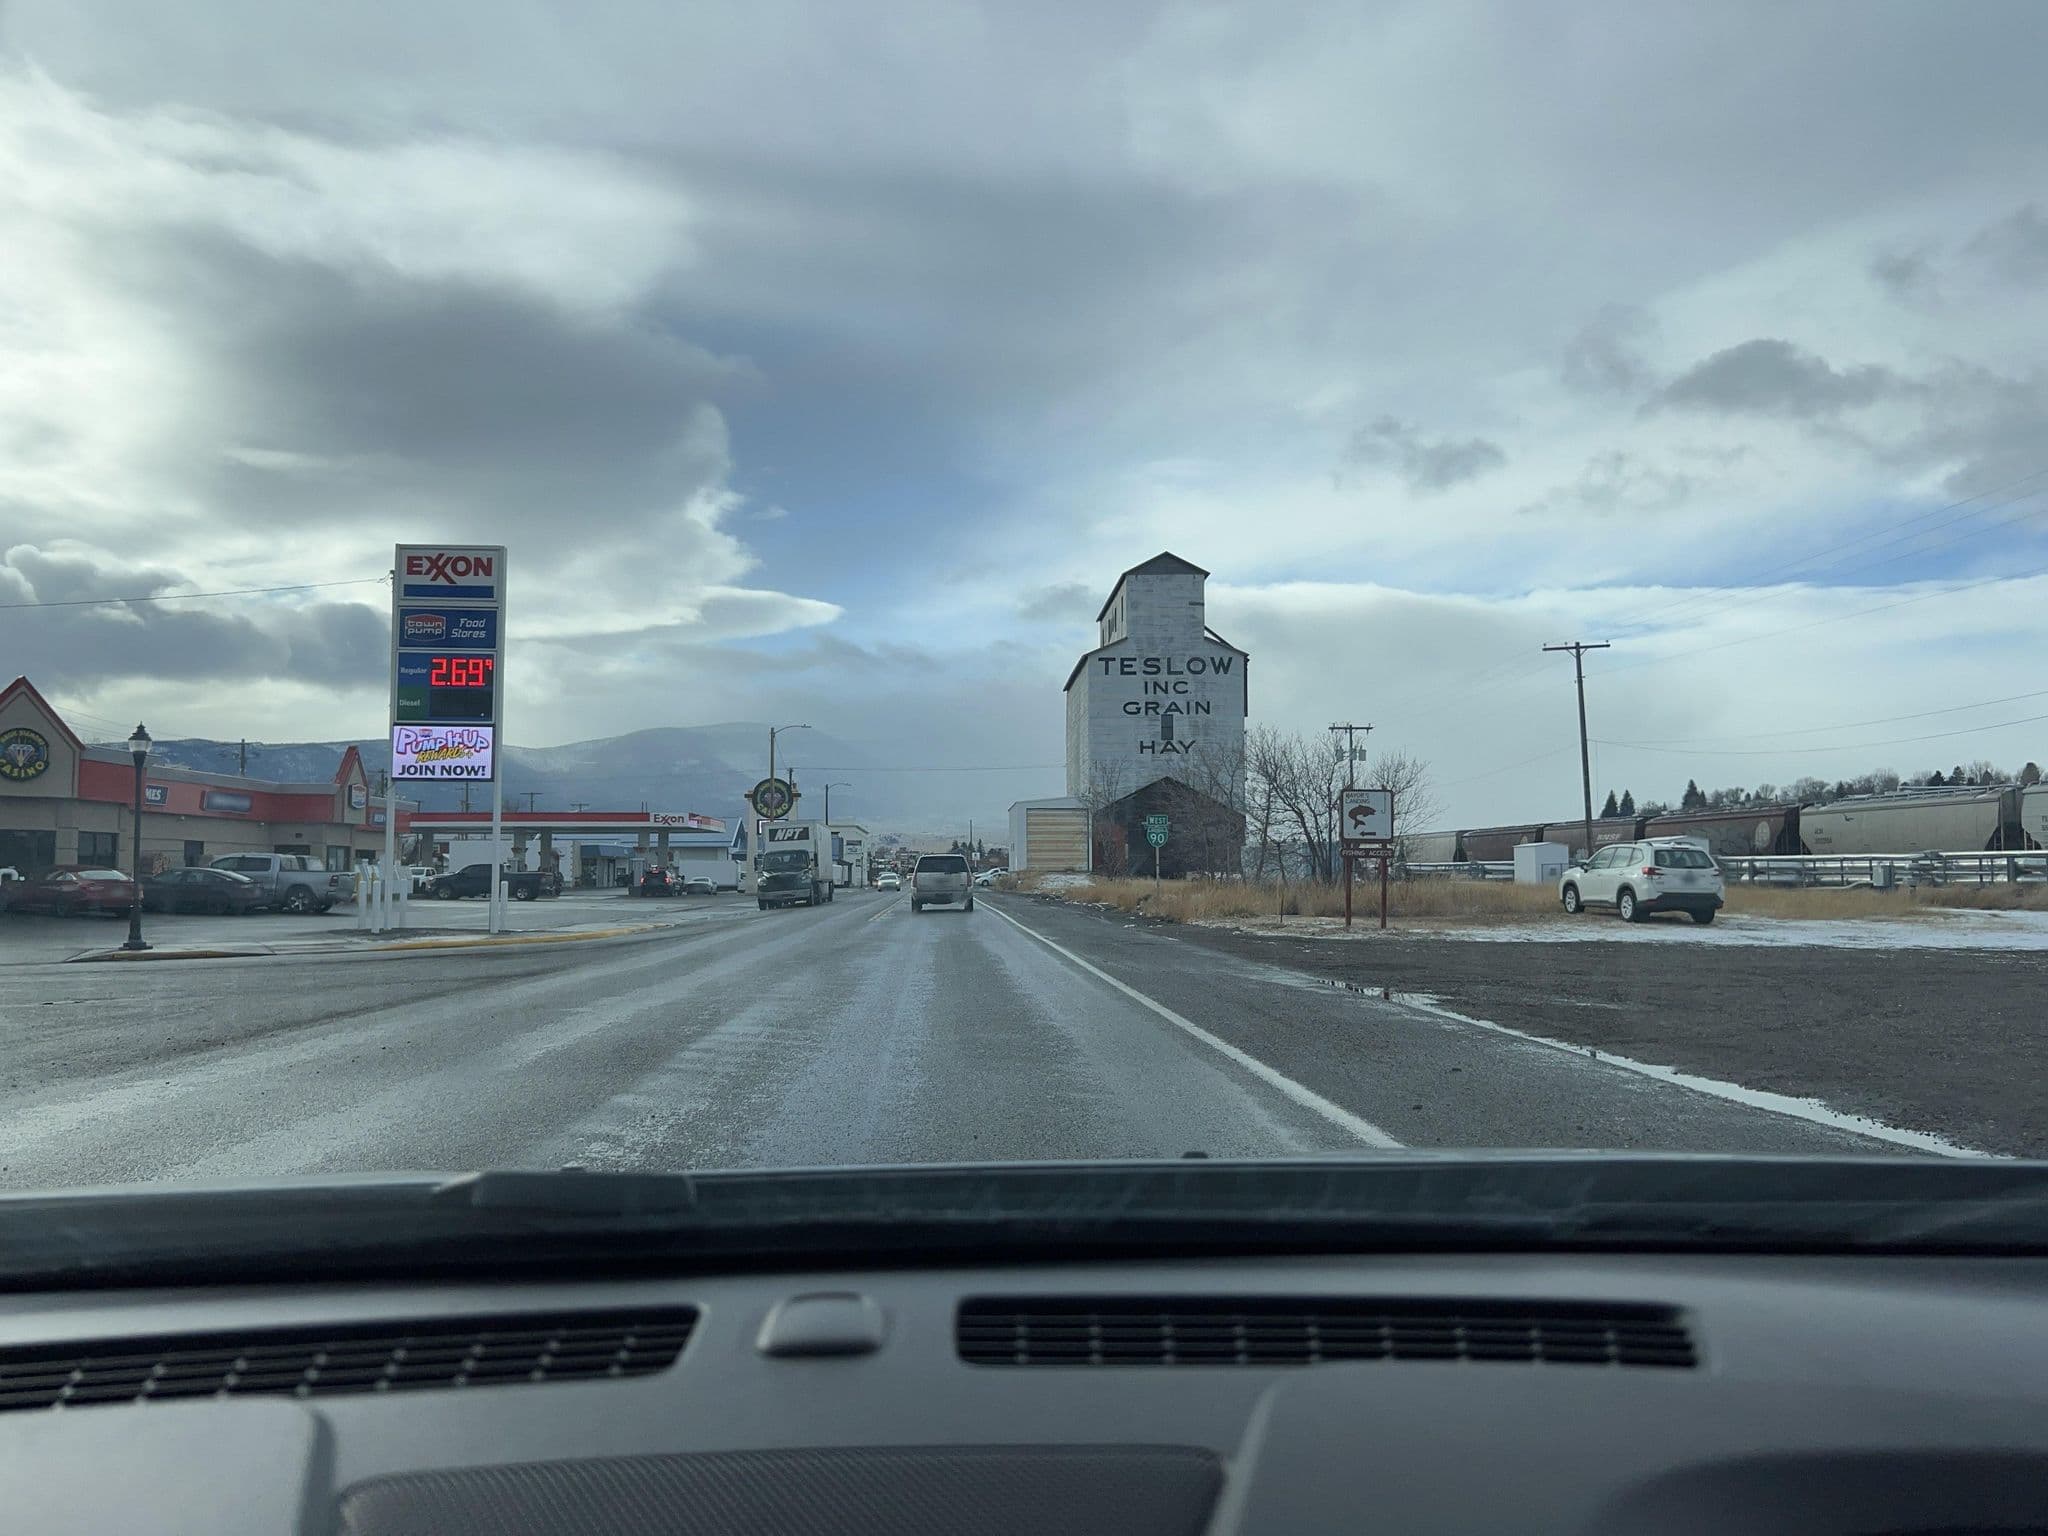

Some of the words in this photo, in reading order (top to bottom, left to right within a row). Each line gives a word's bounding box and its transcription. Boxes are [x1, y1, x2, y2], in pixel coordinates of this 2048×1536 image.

[406, 553, 493, 584] EXXON
[408, 620, 442, 628] town
[459, 618, 486, 628] Food
[451, 628, 486, 638] Stores
[400, 667, 427, 675] Regular
[1098, 656, 1233, 675] TESLOW
[1123, 701, 1211, 715] GRAIN
[1139, 740, 1196, 755] HAY
[398, 765, 435, 776] JOIN
[440, 765, 487, 776] NOW!
[653, 813, 685, 825] Exxon
[775, 828, 804, 841] NPT
[1150, 833, 1165, 843] 90
